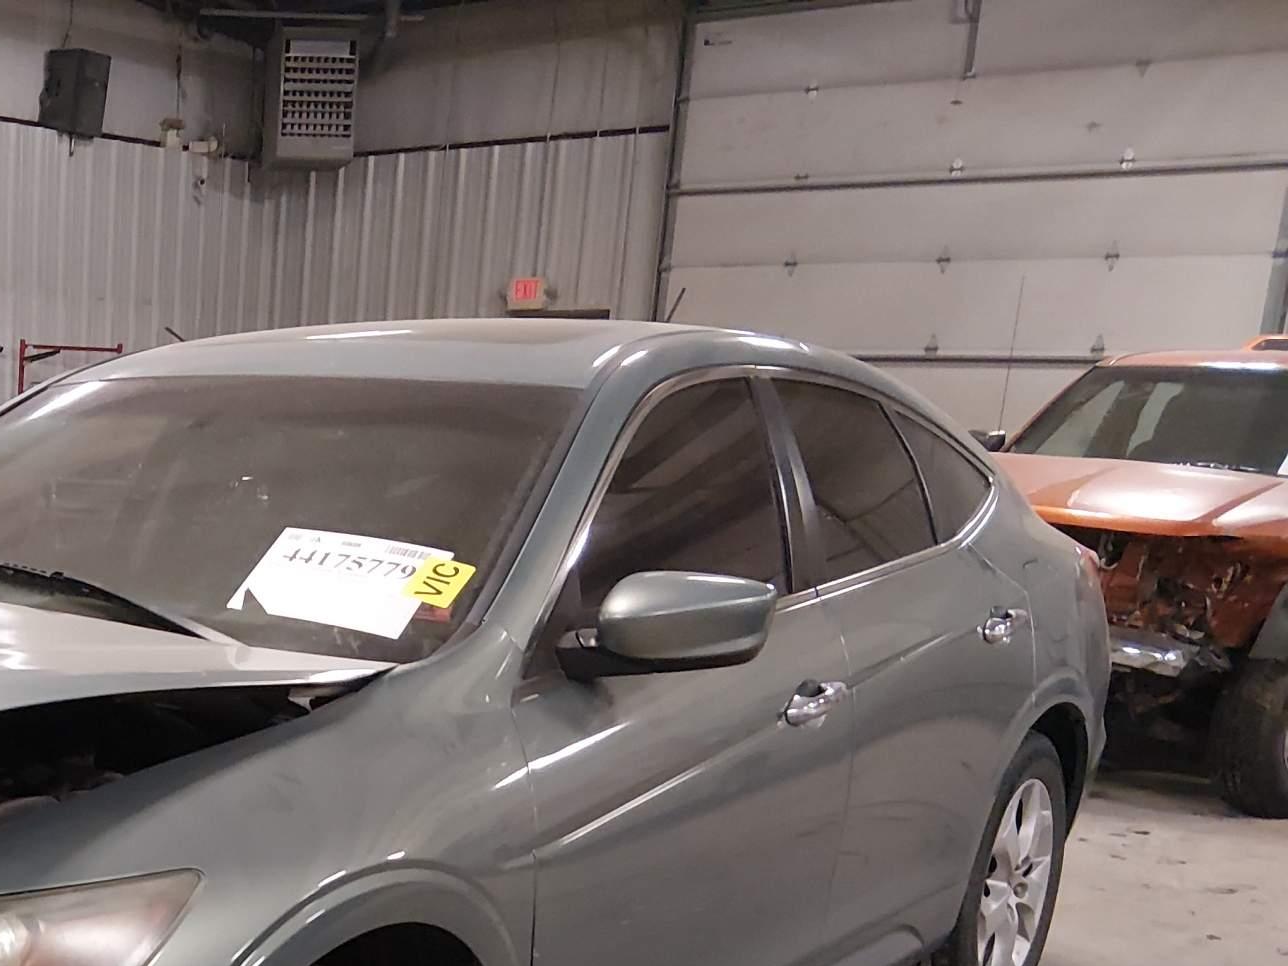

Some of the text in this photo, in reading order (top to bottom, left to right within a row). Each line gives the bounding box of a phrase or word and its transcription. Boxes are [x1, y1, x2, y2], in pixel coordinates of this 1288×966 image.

[515, 280, 537, 299] EXIT
[282, 547, 417, 580] 44175779
[414, 562, 461, 598] VIC
